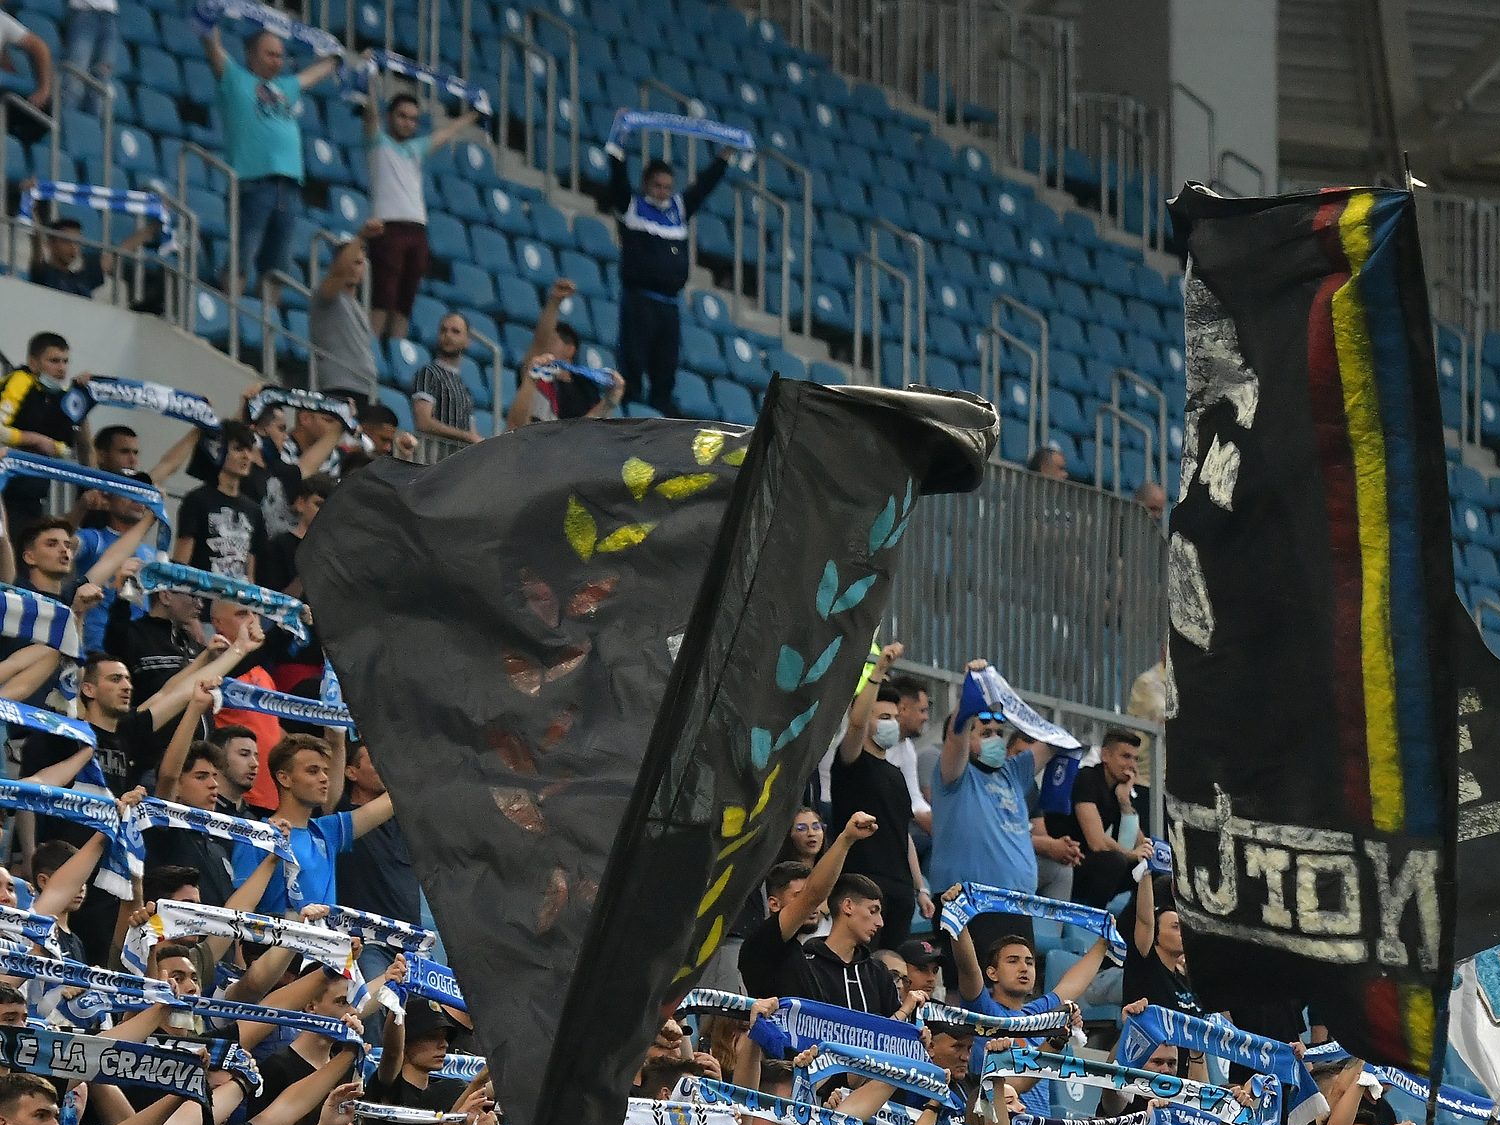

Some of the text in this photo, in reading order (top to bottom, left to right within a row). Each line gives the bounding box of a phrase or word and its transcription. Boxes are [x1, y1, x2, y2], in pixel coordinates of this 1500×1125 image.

[1161, 1007, 1274, 1069] ULTRAS
[50, 1040, 87, 1074] LA
[100, 1048, 208, 1098] CRAIOVA
